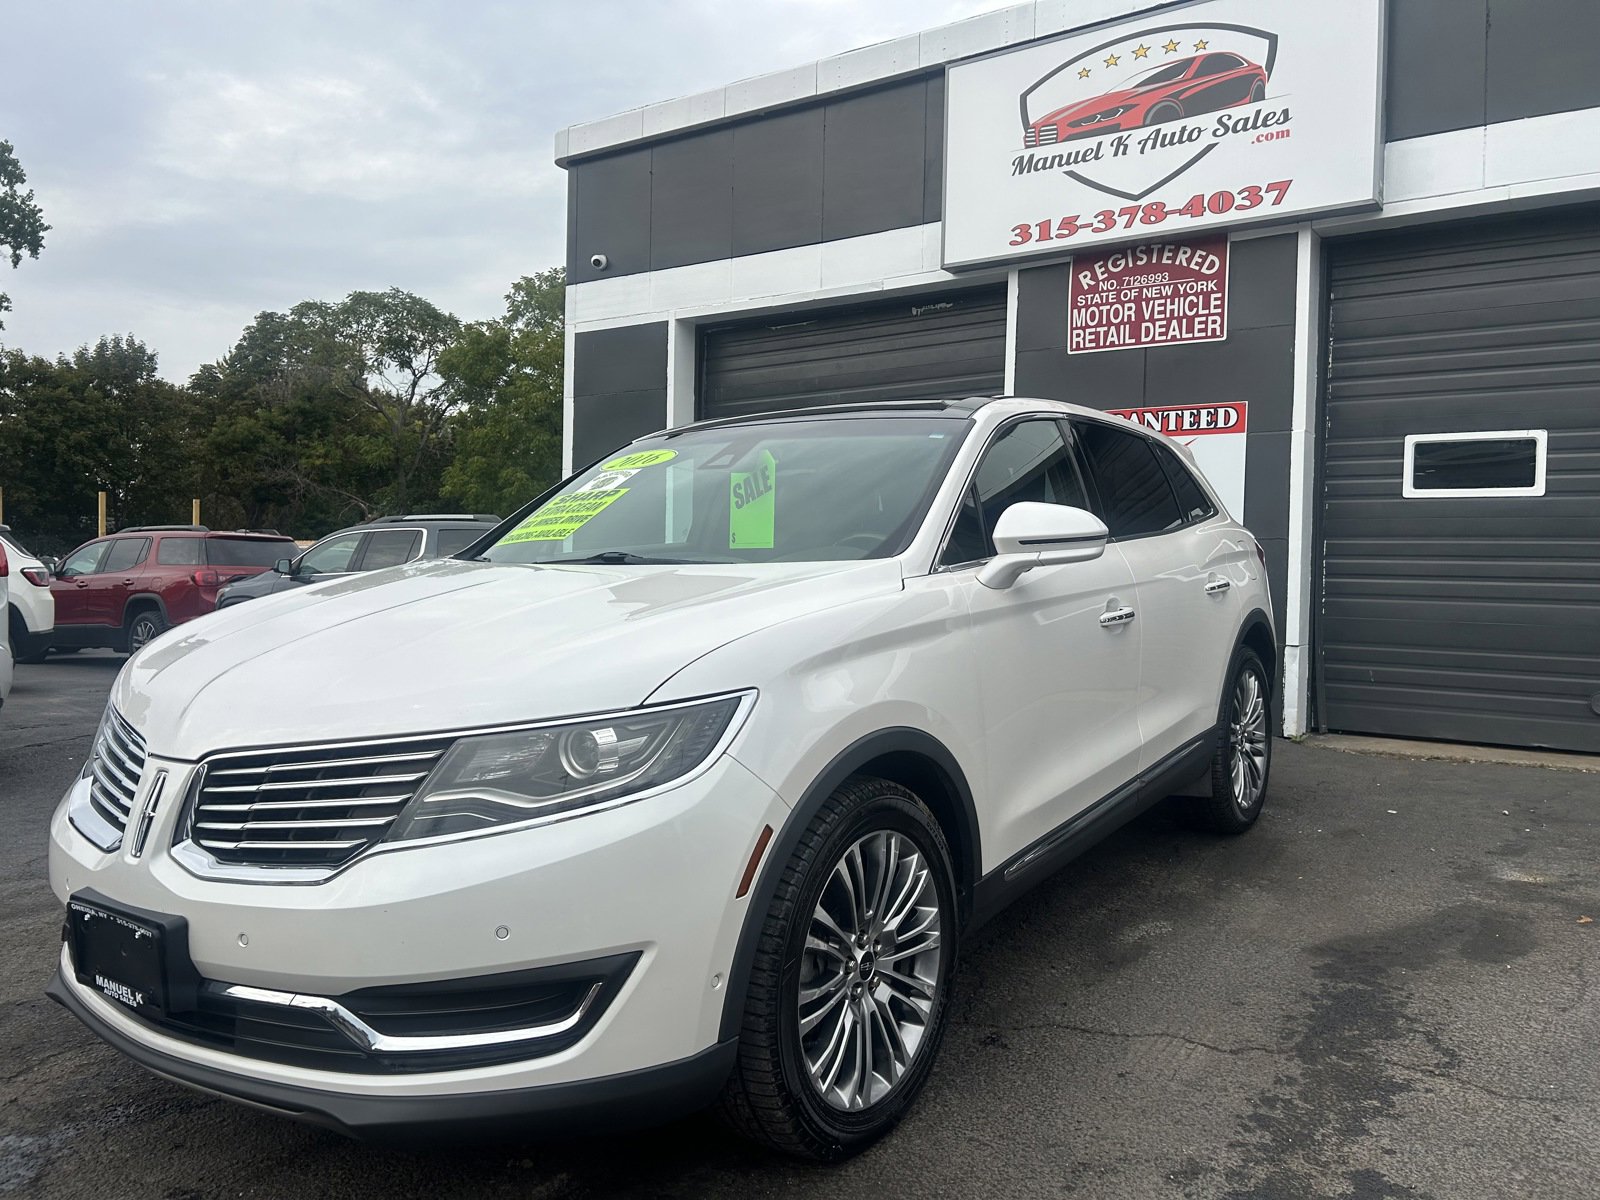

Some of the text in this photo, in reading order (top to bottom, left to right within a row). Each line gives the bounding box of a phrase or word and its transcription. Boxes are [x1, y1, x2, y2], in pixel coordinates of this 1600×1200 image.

[1011, 105, 1293, 177] Manuel K Auto Sales
[1250, 127, 1291, 145] .com
[1009, 179, 1293, 246] 315-378-4037
[1078, 244, 1220, 290] REGISTERED
[1099, 272, 1169, 291] NO. 7126993
[1077, 280, 1217, 306] STATE OF NEW YORK
[1072, 293, 1222, 328] MOTOR VEHICLE
[1072, 315, 1221, 349] RETAIL DEALER
[553, 489, 621, 506] SHARP
[732, 464, 773, 510] SALE
[95, 974, 144, 1005] MANUEL K
[104, 987, 137, 1007] AUTO SALES
